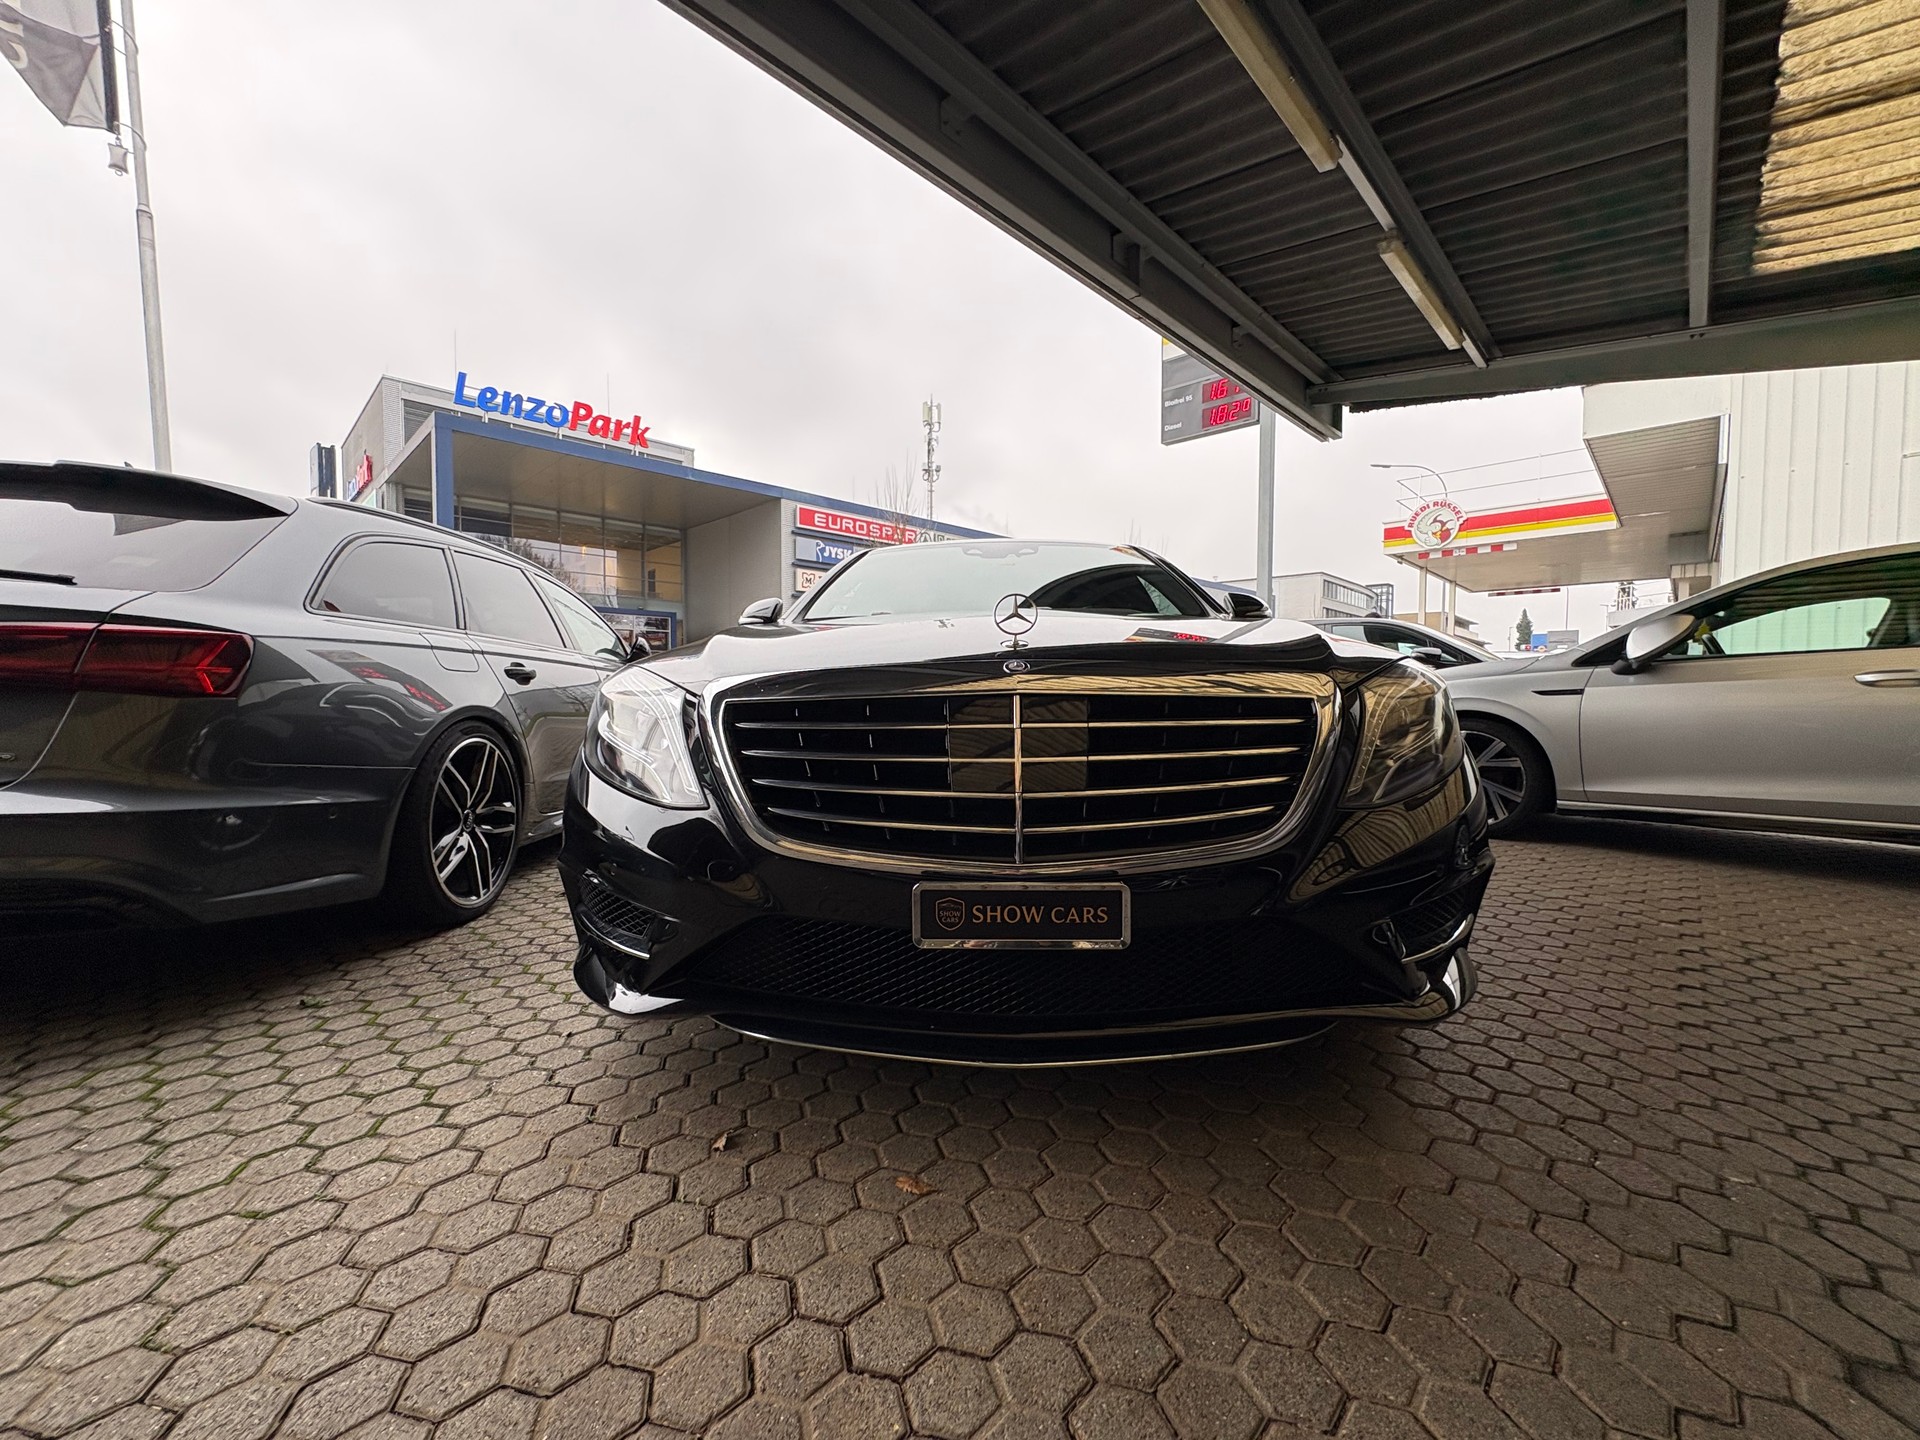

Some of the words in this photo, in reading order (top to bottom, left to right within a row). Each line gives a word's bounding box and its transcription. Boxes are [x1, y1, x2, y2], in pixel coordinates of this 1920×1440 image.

[453, 371, 651, 448] LenzoPark
[814, 512, 916, 543] EUROSPAR
[1407, 503, 1431, 528] RUEDI
[1432, 500, 1464, 522] RÜSSEL
[972, 905, 1045, 924] SHOW
[1051, 907, 1108, 924] CARS
